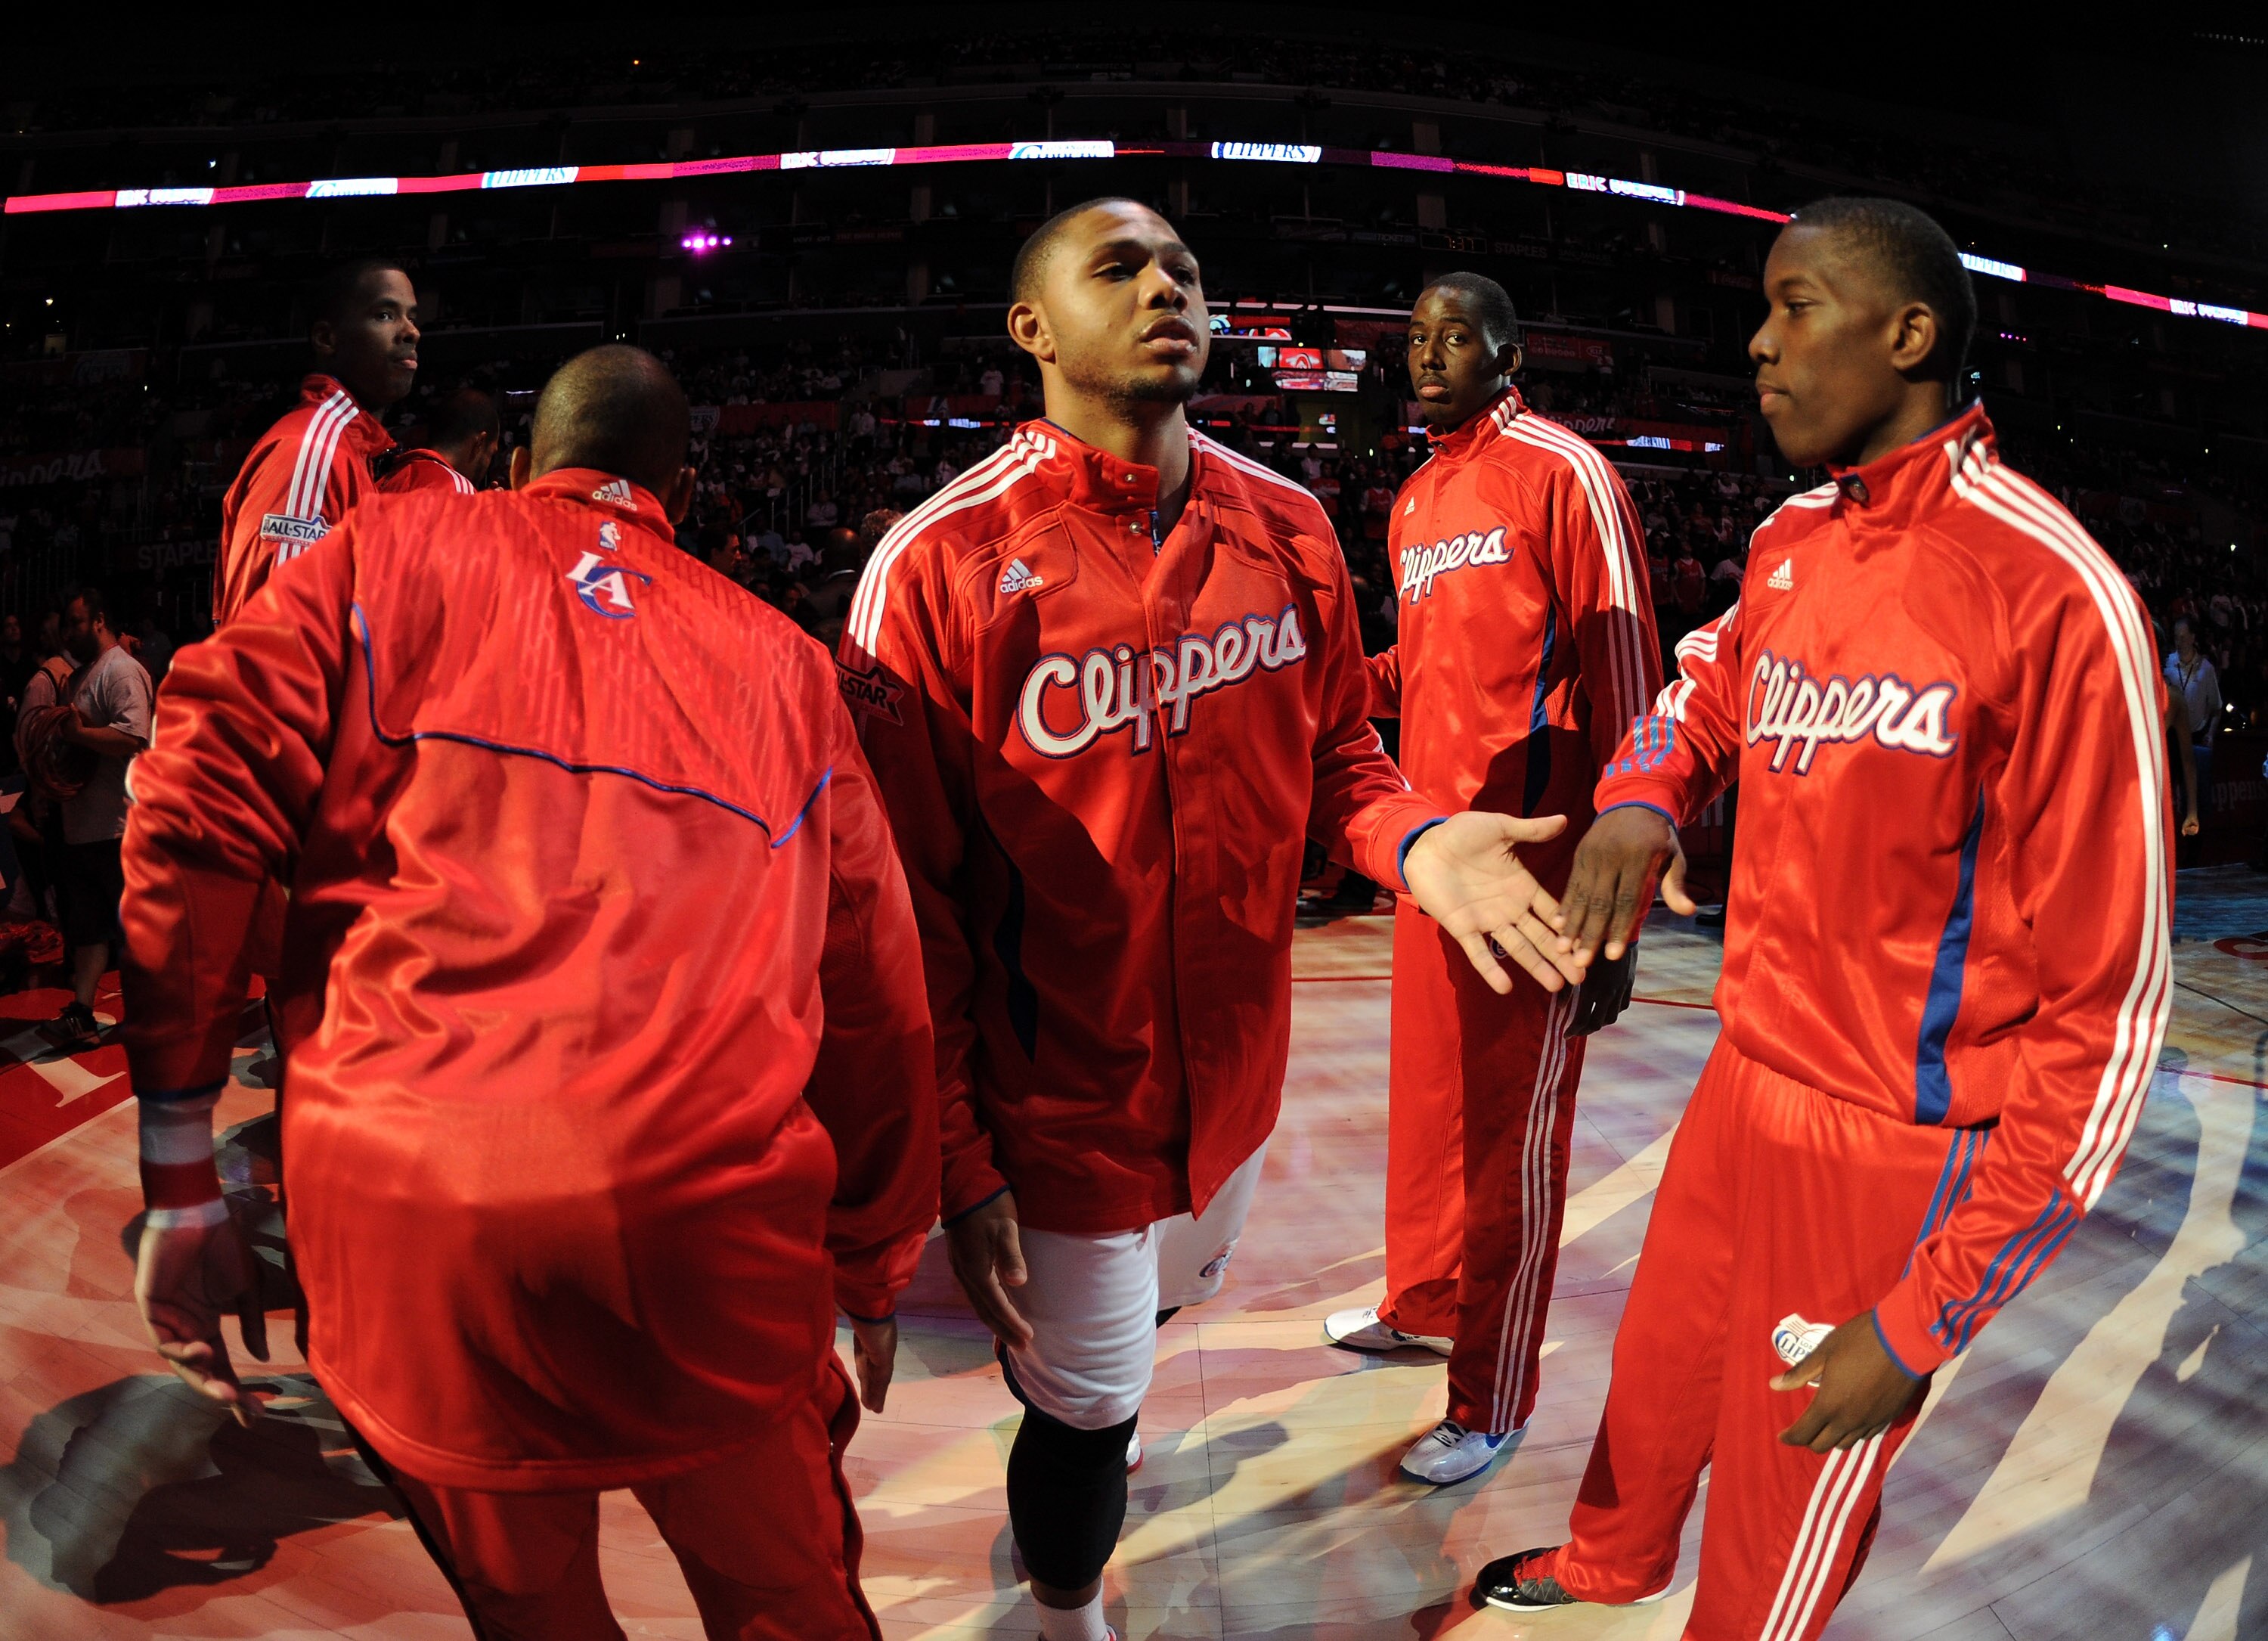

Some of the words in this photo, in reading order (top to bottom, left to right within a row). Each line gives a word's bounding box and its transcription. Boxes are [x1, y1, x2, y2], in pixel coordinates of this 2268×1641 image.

[591, 489, 638, 512] adidas
[999, 575, 1044, 594] adidas
[1017, 603, 1306, 759] Clippers
[1746, 648, 1960, 776] Clippers
